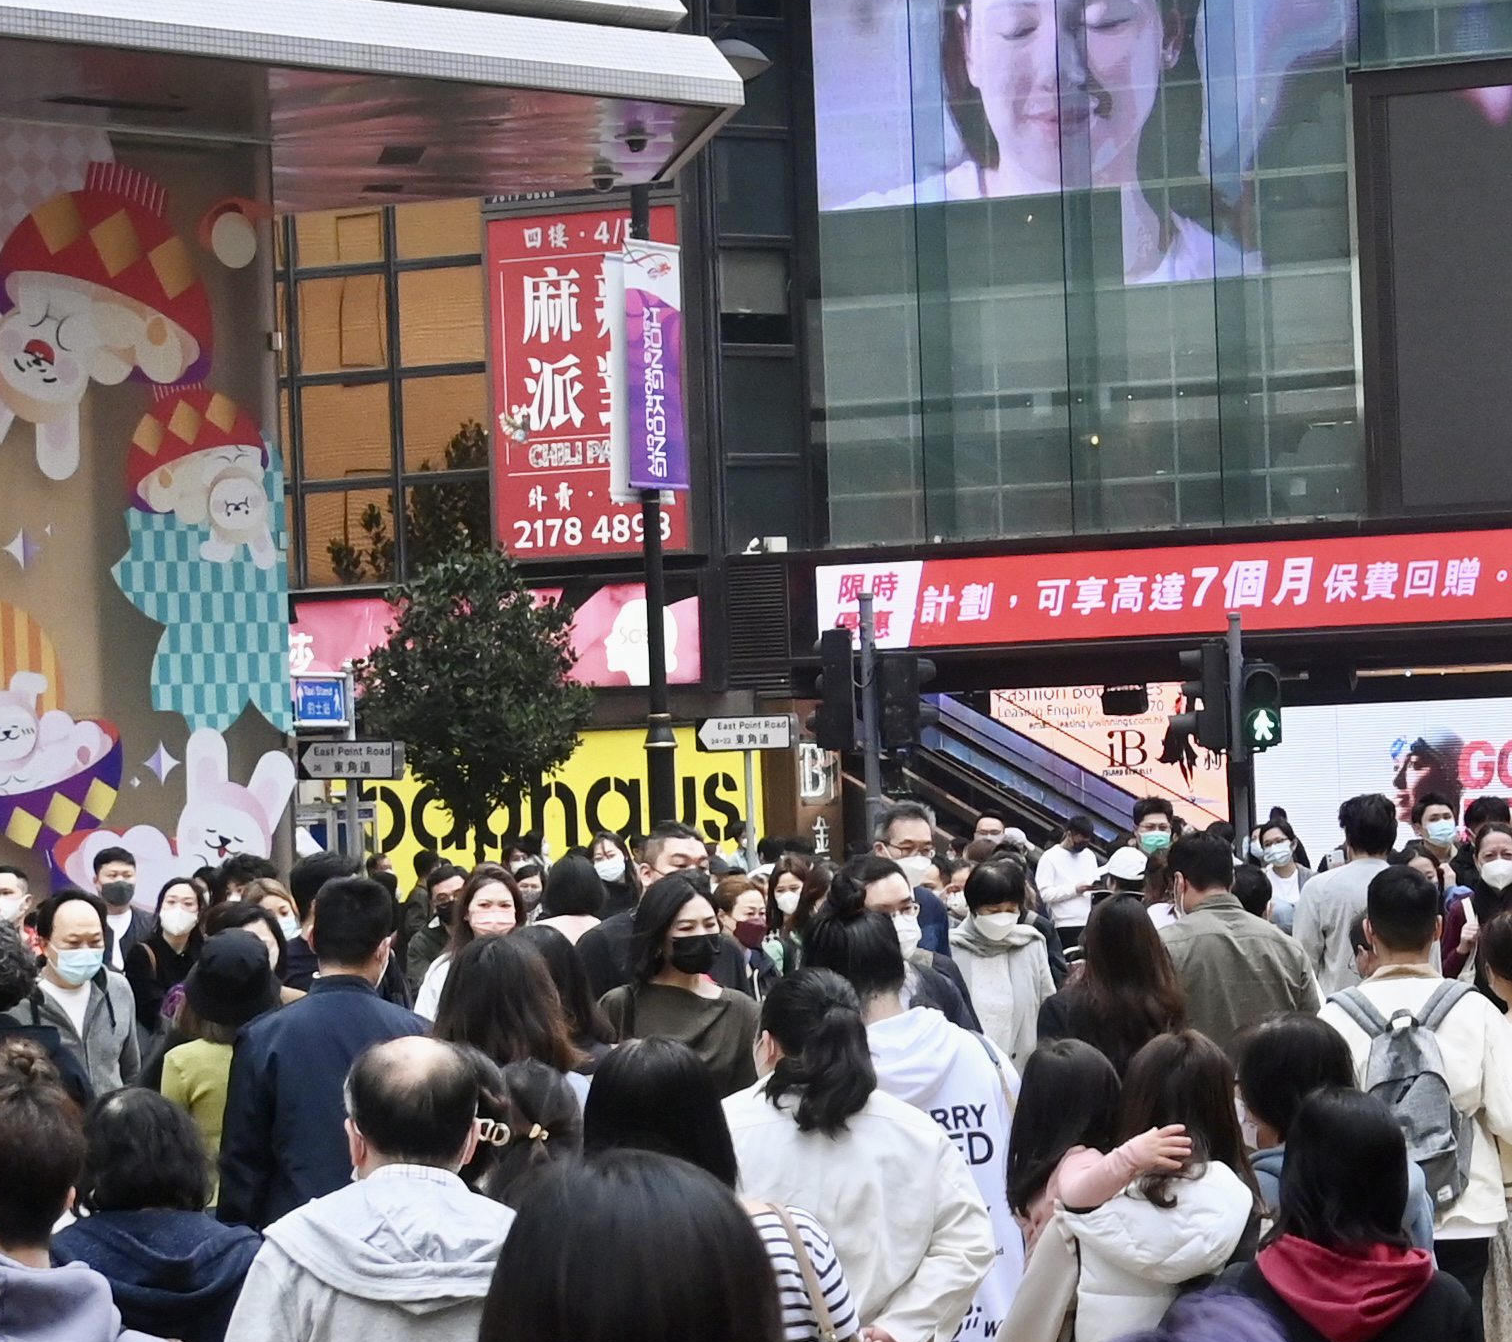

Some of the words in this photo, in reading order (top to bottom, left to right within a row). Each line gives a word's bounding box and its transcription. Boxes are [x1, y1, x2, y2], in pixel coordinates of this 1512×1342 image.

[522, 226, 570, 250] 四樓
[650, 307, 665, 392] HONG
[644, 362, 655, 424] WORLD
[646, 424, 657, 477] CITY
[653, 395, 668, 479] KONG
[513, 517, 583, 550] 2178
[837, 571, 898, 603] 限時
[717, 721, 737, 731] East
[739, 720, 762, 730] Point
[764, 719, 787, 729] Road
[735, 733, 769, 745] 東角道
[313, 746, 335, 756] East
[337, 746, 363, 756] Point
[366, 745, 392, 756] Road
[333, 761, 371, 774] 東角道
